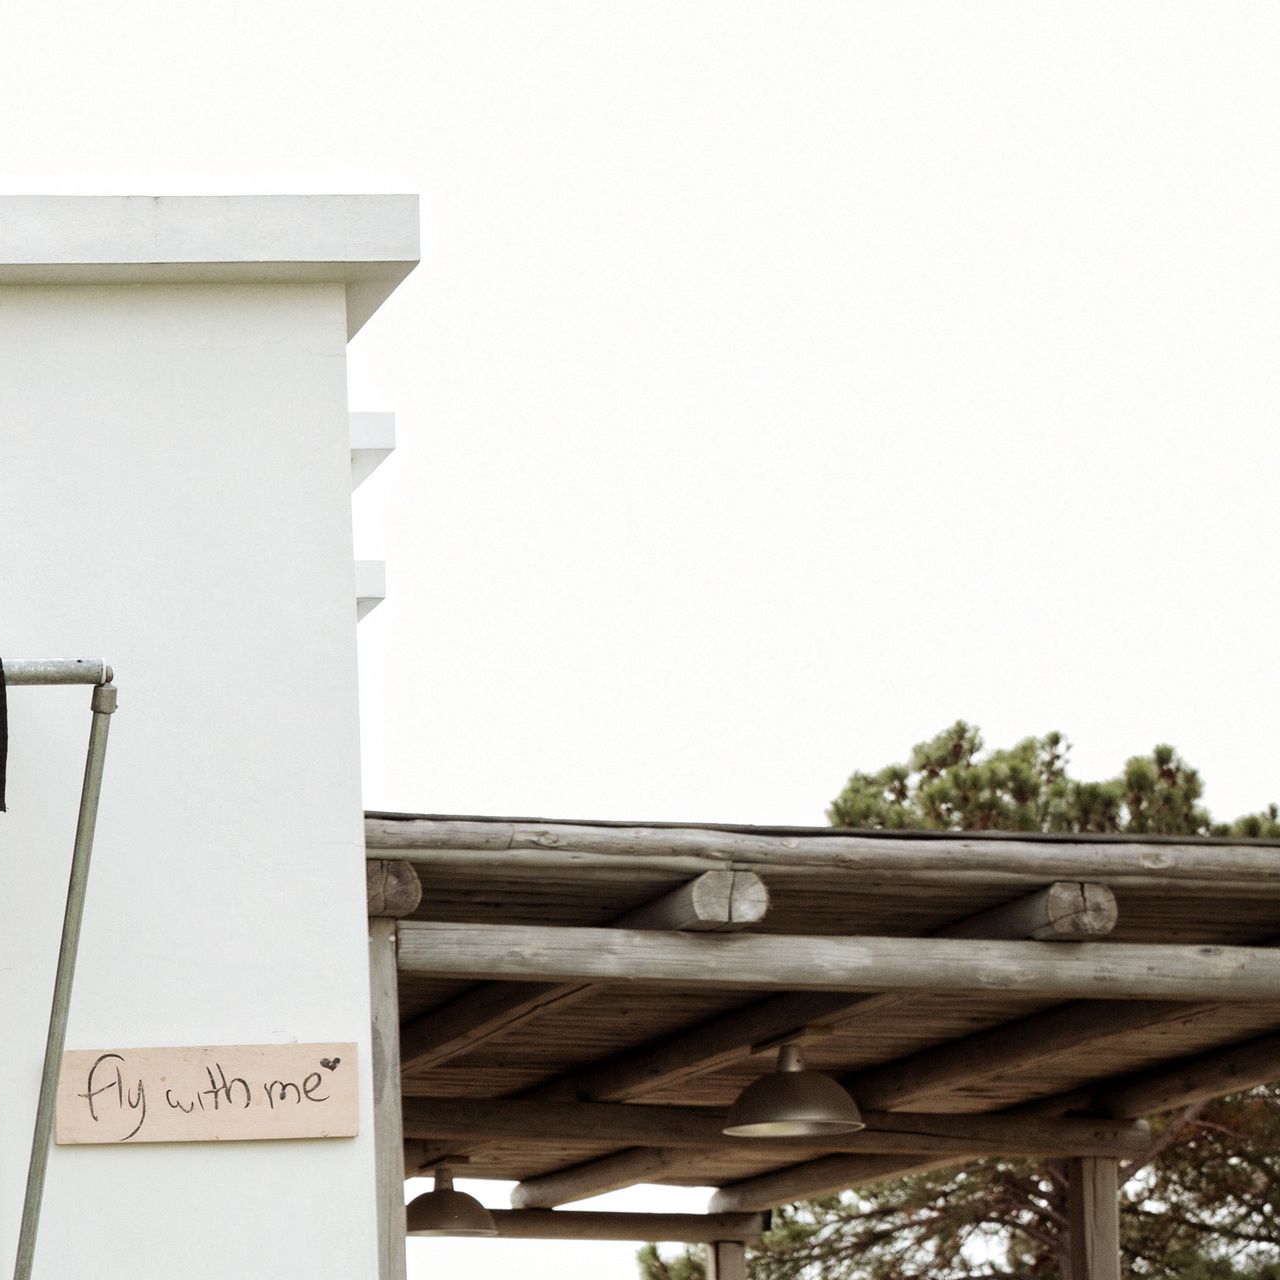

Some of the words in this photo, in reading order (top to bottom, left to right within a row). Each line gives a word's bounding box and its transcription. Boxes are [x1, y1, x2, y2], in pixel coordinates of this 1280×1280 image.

[77, 1053, 147, 1141] fly
[165, 1062, 252, 1112] with
[264, 1070, 330, 1110] me
